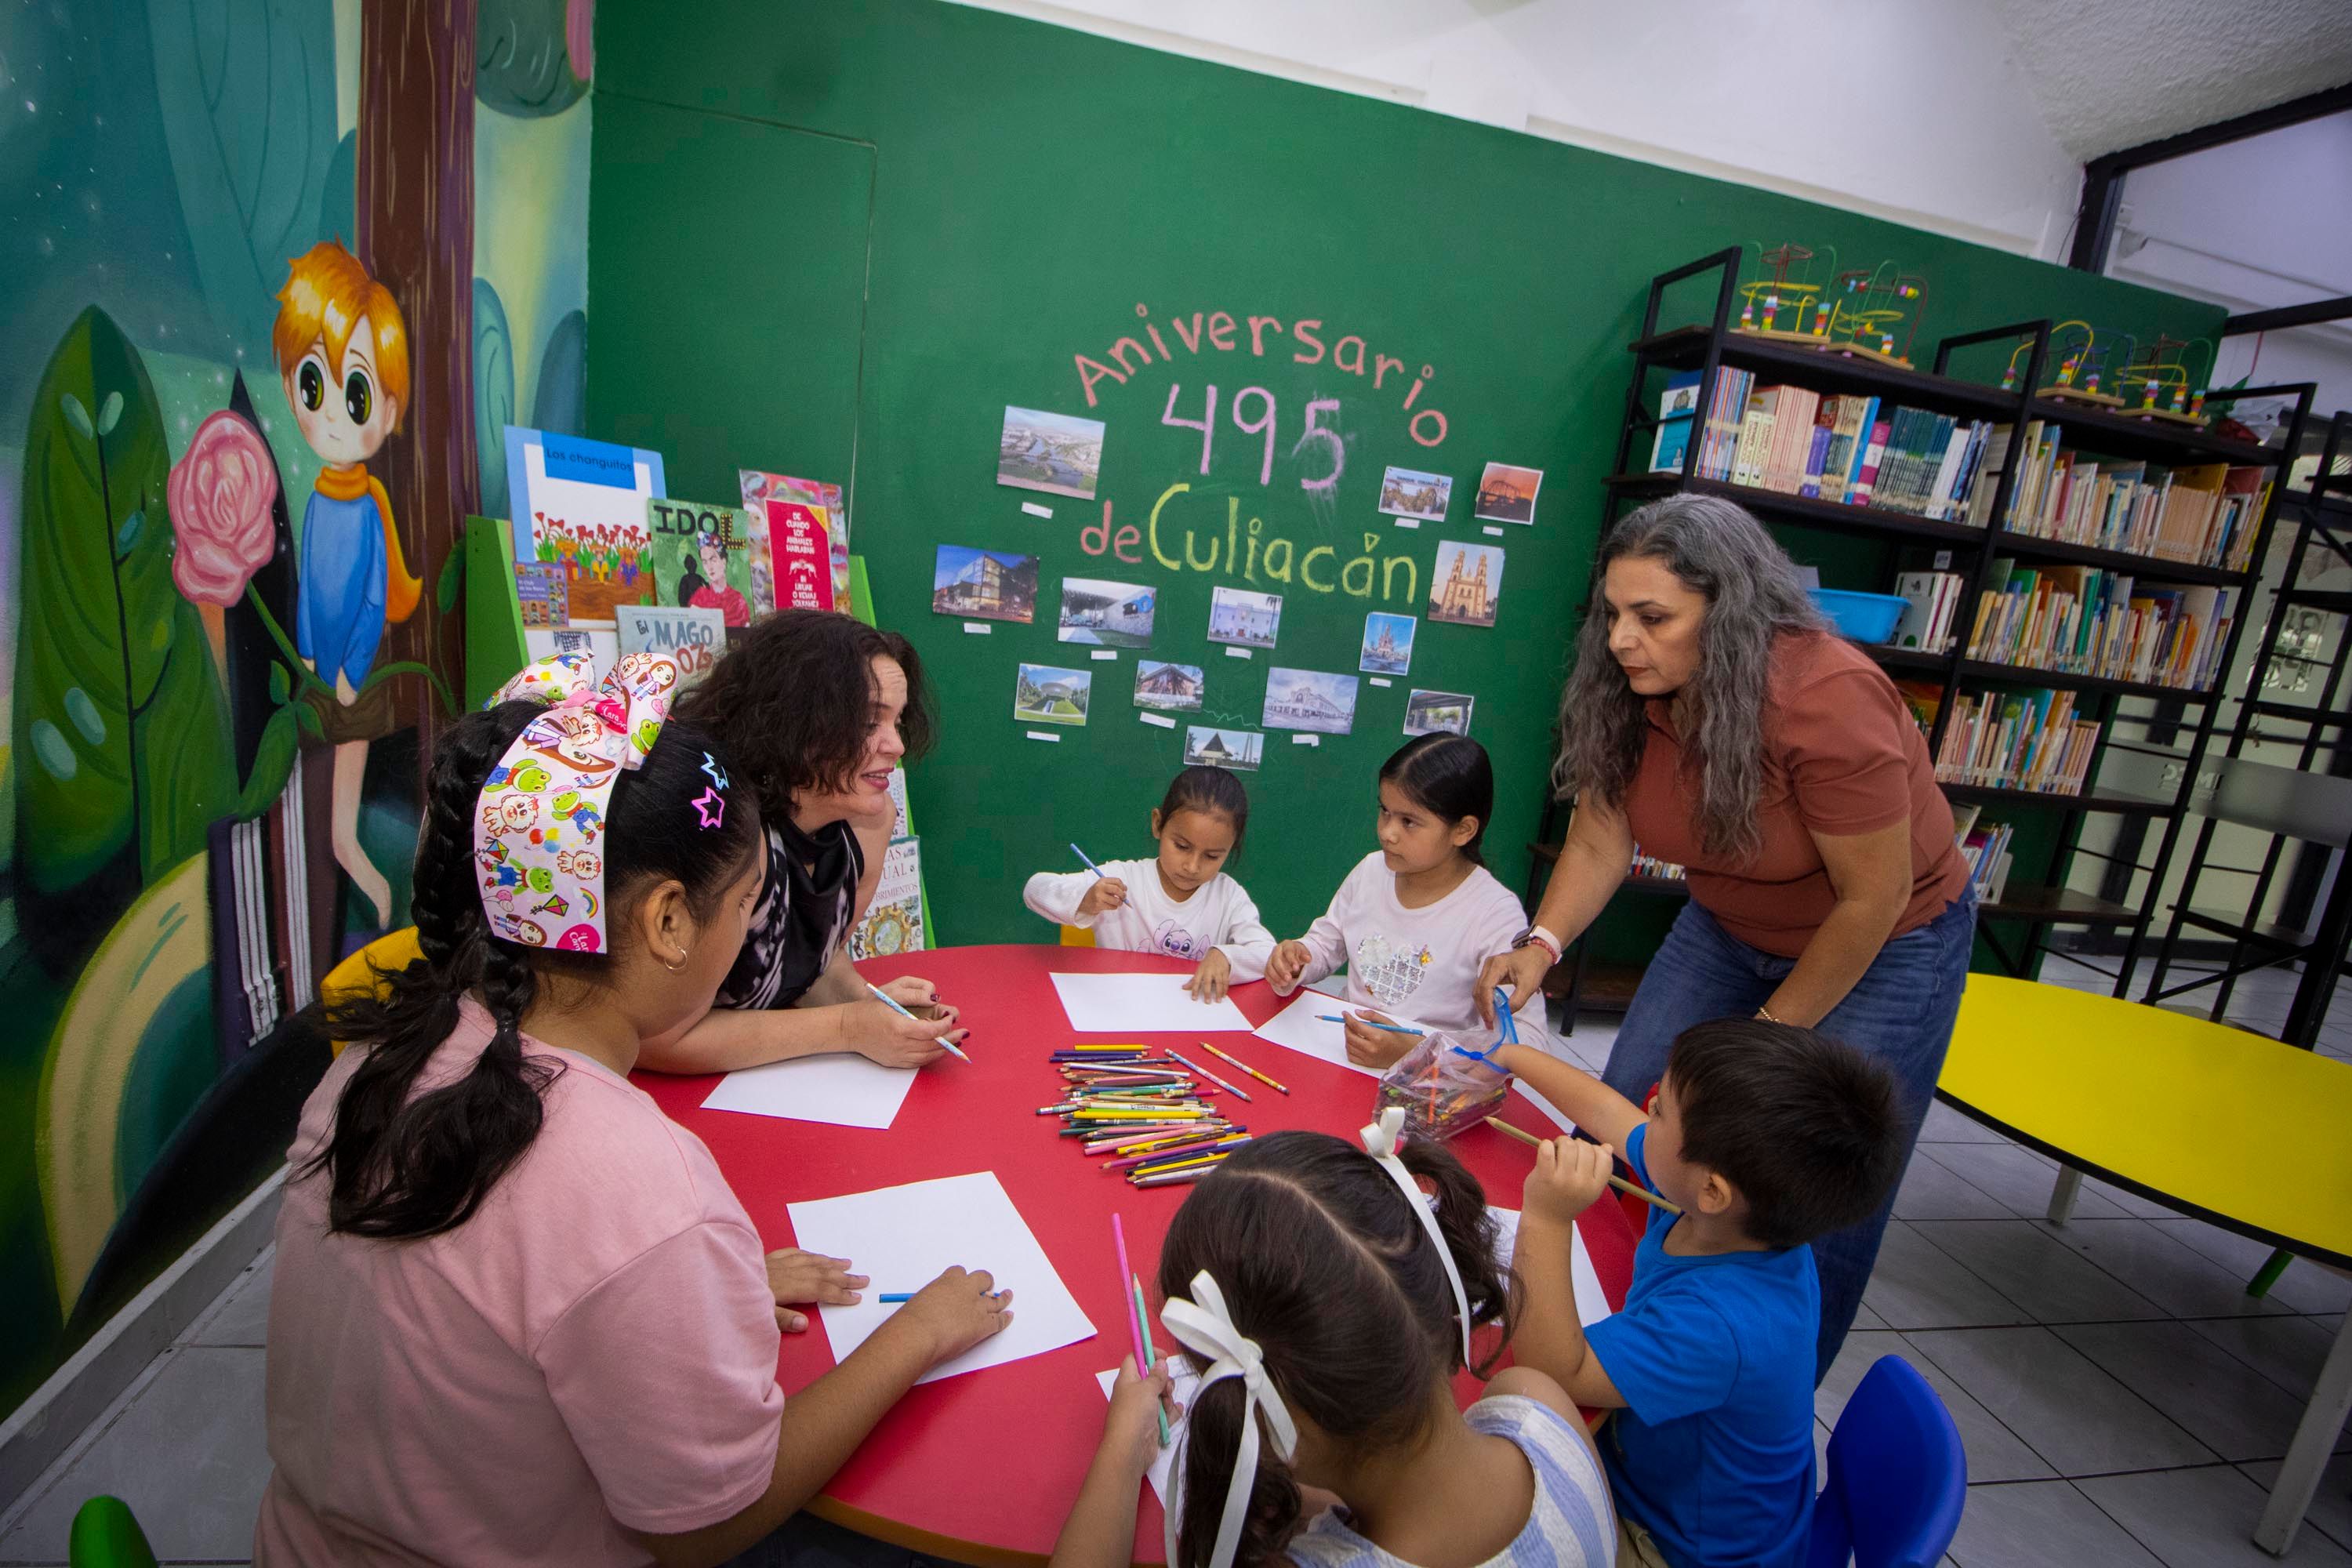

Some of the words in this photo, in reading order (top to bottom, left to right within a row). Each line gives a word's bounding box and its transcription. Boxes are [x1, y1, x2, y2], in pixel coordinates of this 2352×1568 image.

[1074, 303, 1448, 448] Aniversario
[1162, 384, 1346, 490] 495
[546, 448, 565, 460] Los
[569, 453, 633, 471] changuitos
[652, 504, 746, 550] IDOL
[786, 520, 810, 530] CUANDO
[1080, 499, 1142, 564] de
[1149, 483, 1417, 604] Culiacán
[654, 620, 713, 650] MAGO
[603, 706, 619, 722] Lara
